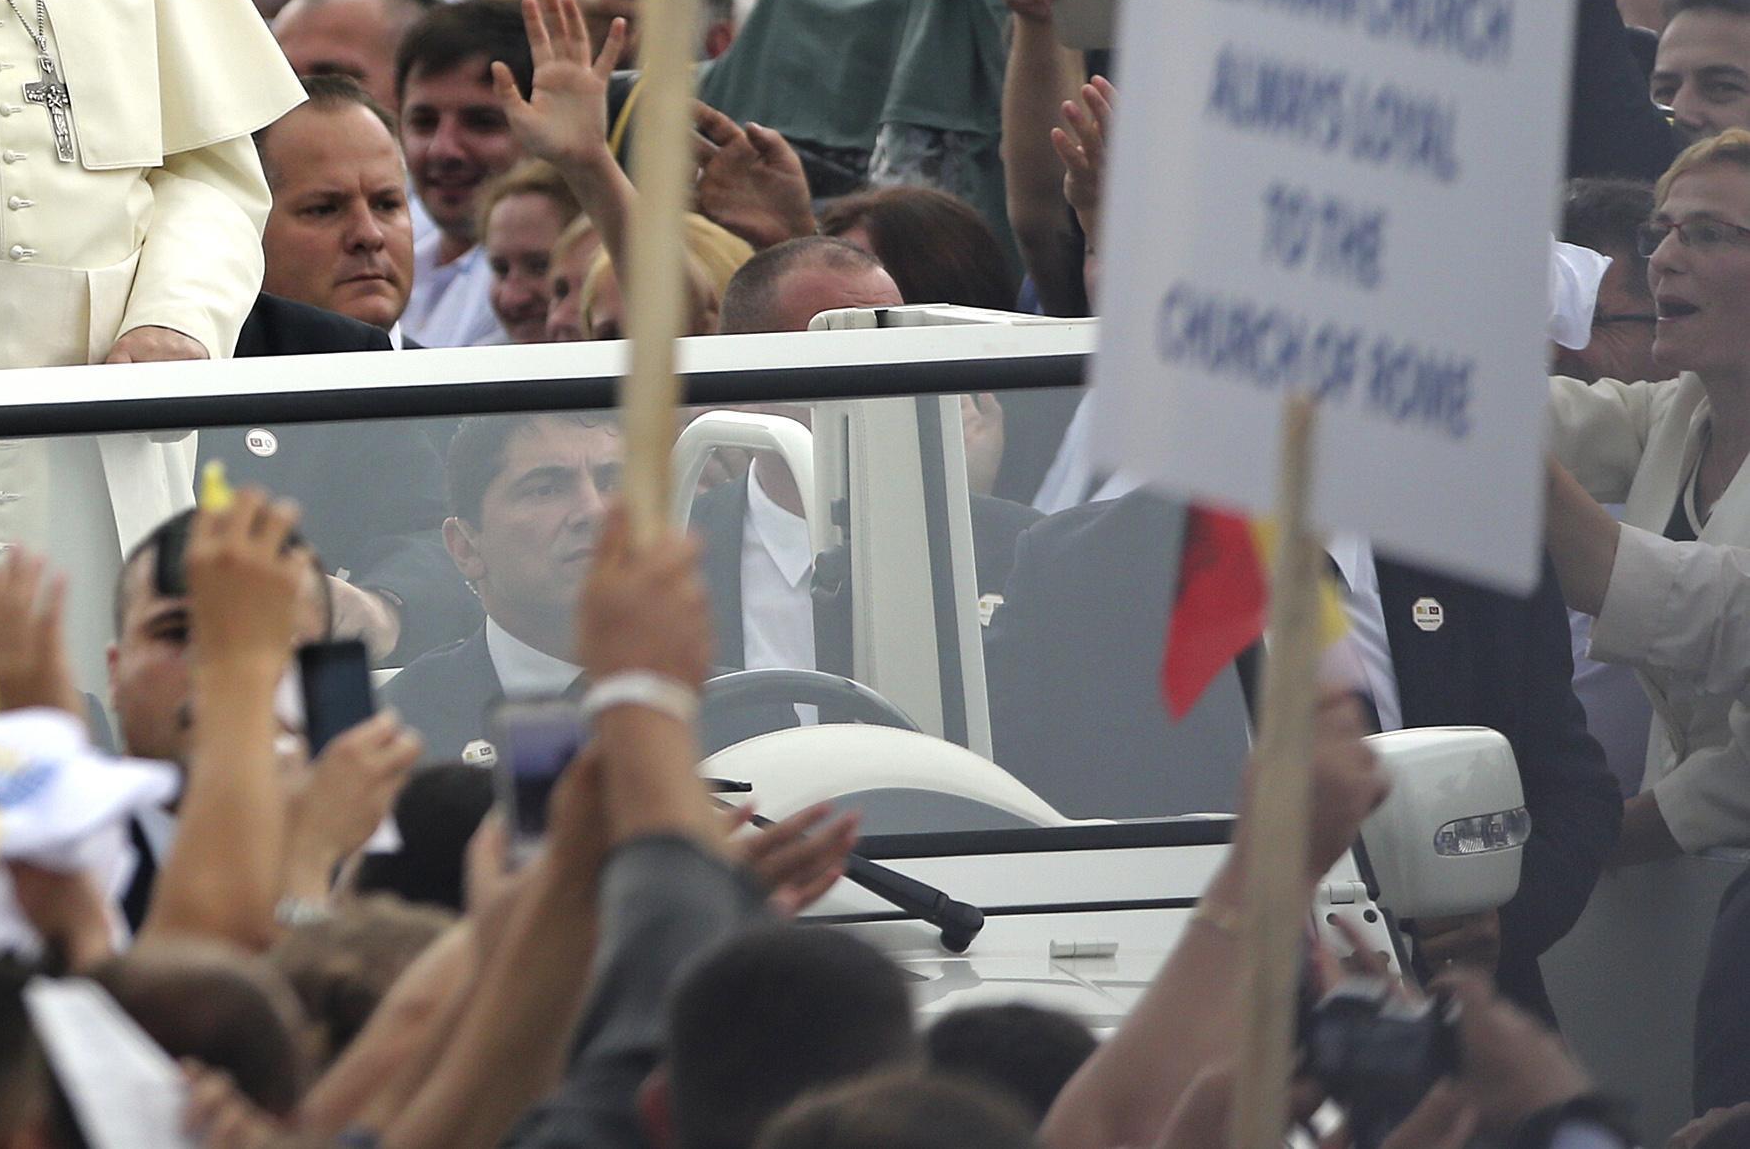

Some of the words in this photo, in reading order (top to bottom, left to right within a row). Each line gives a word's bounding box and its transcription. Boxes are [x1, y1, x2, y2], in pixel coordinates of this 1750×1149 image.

[1207, 44, 1343, 150] ALWAYS
[1354, 79, 1458, 183] LOYAL
[1263, 182, 1311, 267] TO
[1319, 193, 1385, 289] THE
[1156, 280, 1304, 389] CHURCH
[1313, 320, 1362, 400] OF
[1366, 333, 1477, 439] ROME
